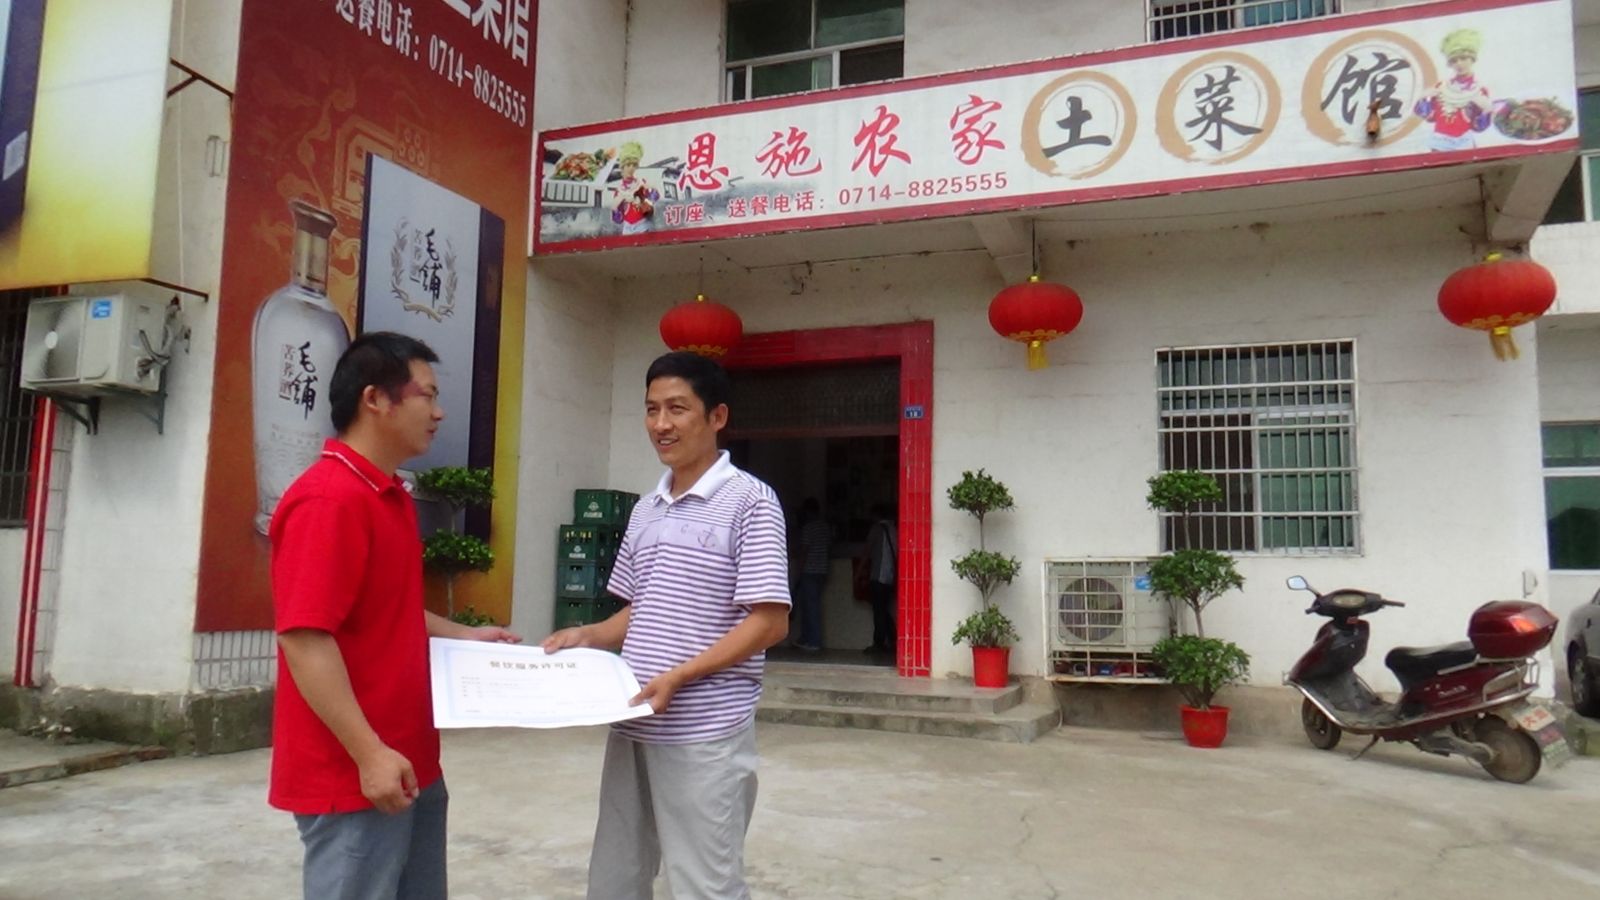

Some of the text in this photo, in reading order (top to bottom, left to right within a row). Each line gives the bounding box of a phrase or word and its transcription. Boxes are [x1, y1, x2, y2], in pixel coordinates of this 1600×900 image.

[429, 34, 526, 127] 0714-8825555
[665, 171, 1008, 225] 订座、送餐电话: 0714-8825555
